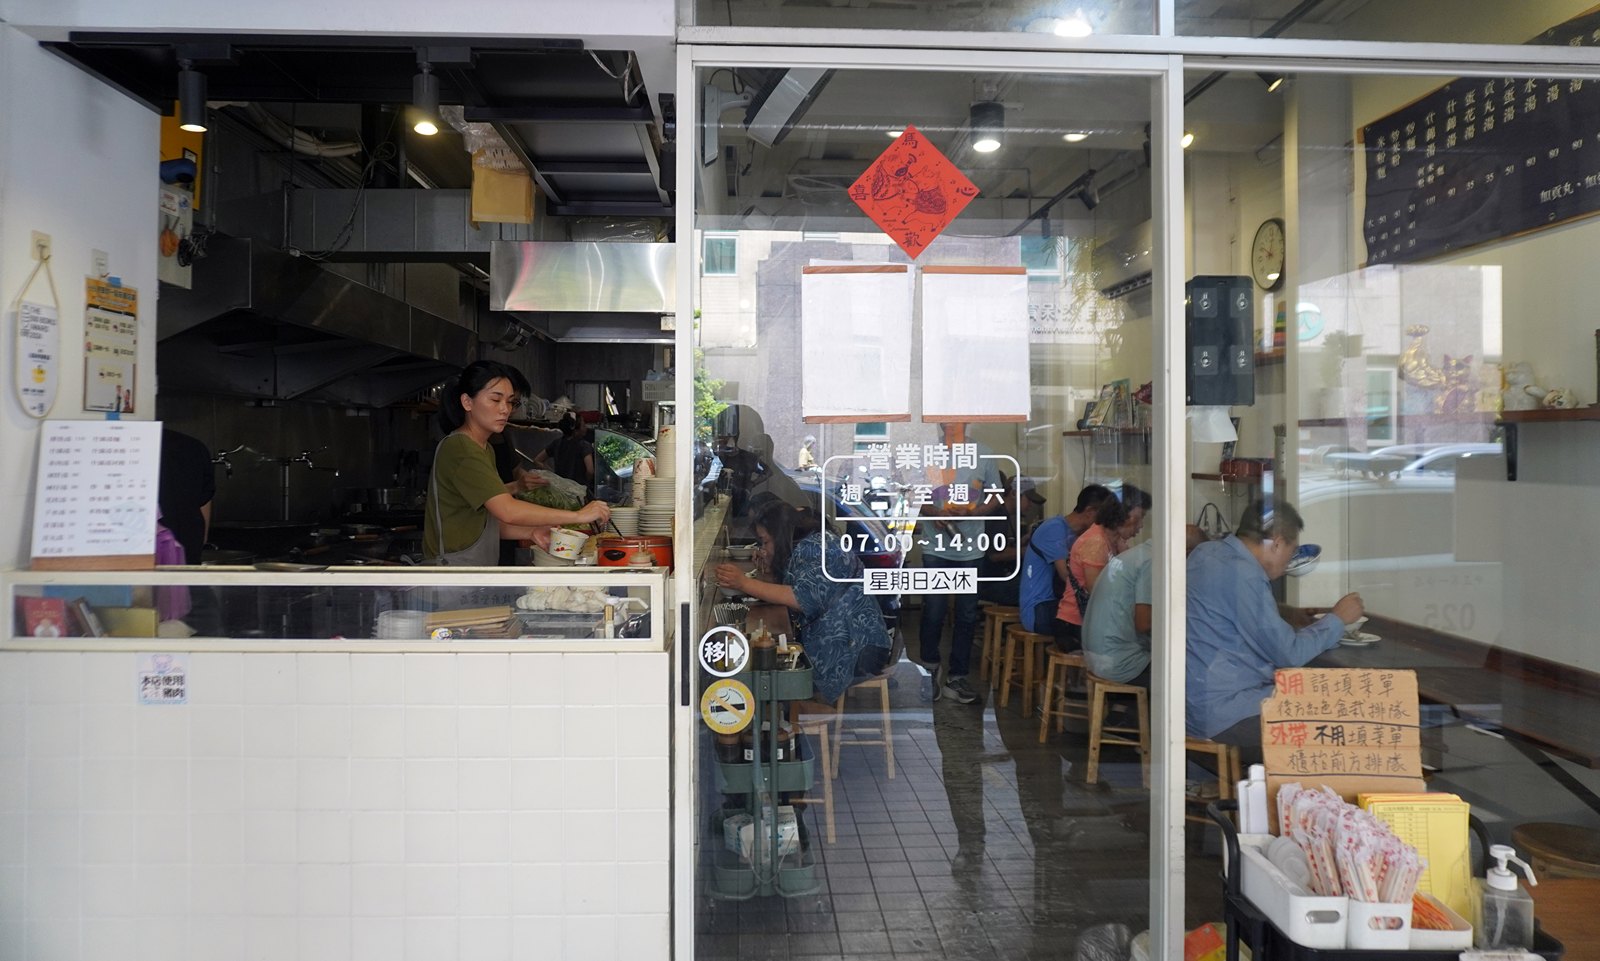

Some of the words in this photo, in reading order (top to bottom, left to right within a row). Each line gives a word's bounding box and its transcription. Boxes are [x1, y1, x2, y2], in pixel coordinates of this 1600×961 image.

[1464, 89, 1476, 140] 蛋花湯
[1483, 80, 1495, 132] 貢丸湯
[851, 184, 870, 200] 喜
[902, 231, 922, 247] 歡
[866, 443, 978, 470] 營業時間
[840, 483, 1005, 506] 週一至週六
[840, 533, 1007, 552] 07:00~14:00
[869, 571, 972, 591] 星期日公休
[704, 641, 726, 663] 移
